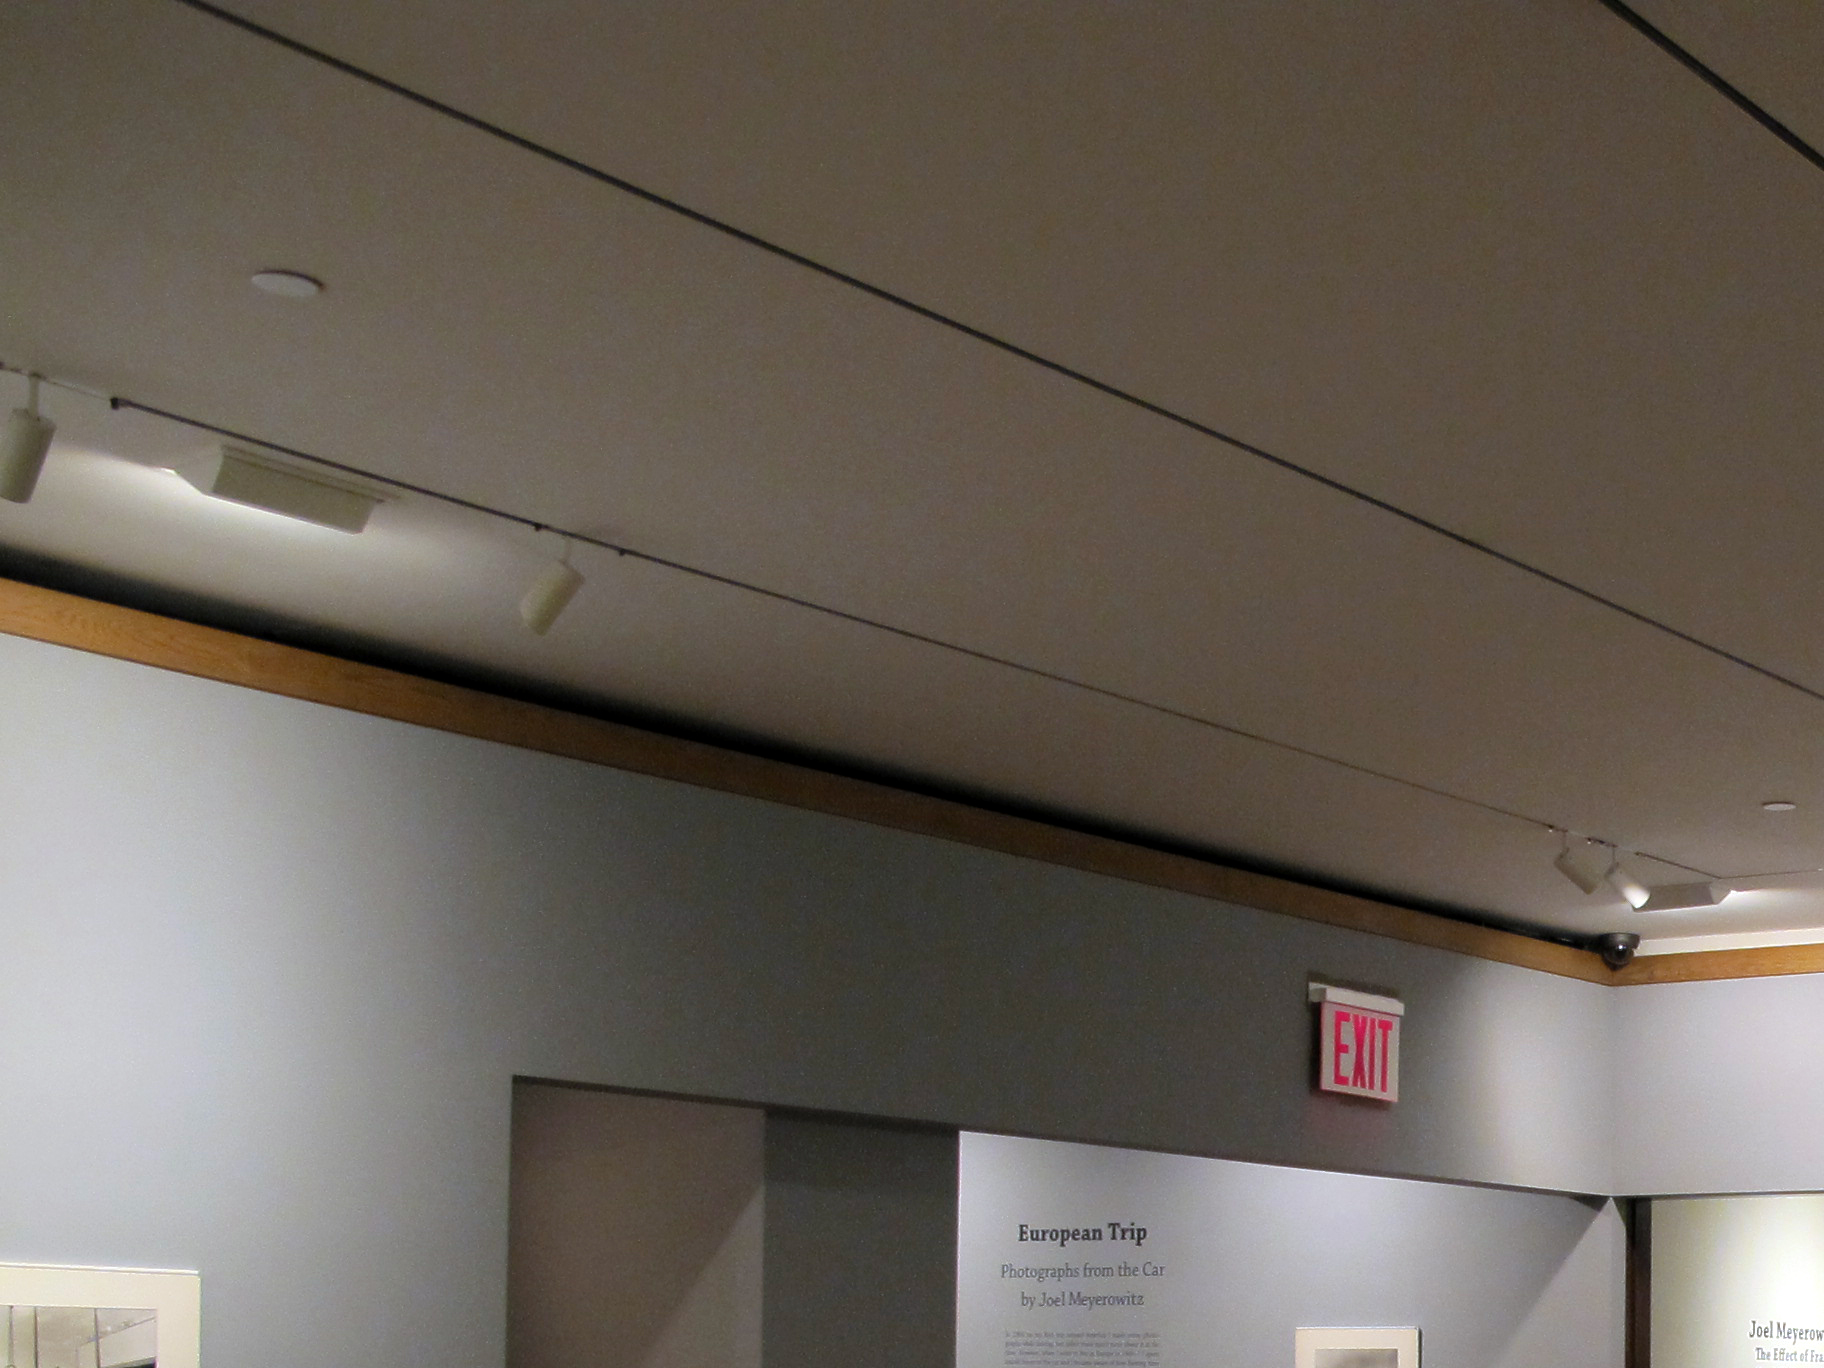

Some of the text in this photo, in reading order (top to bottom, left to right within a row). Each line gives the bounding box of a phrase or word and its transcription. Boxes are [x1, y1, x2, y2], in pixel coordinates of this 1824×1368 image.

[1334, 1010, 1393, 1093] EXIT
[1018, 1222, 1147, 1247] European Trip
[1001, 1261, 1166, 1283] Photographs from the Car
[1021, 1290, 1144, 1310] by Joel Meyerowitz
[1749, 1320, 1774, 1339] Joel
[1755, 1347, 1771, 1360] The
[1773, 1347, 1798, 1362] Effect
[1800, 1349, 1808, 1362] of
